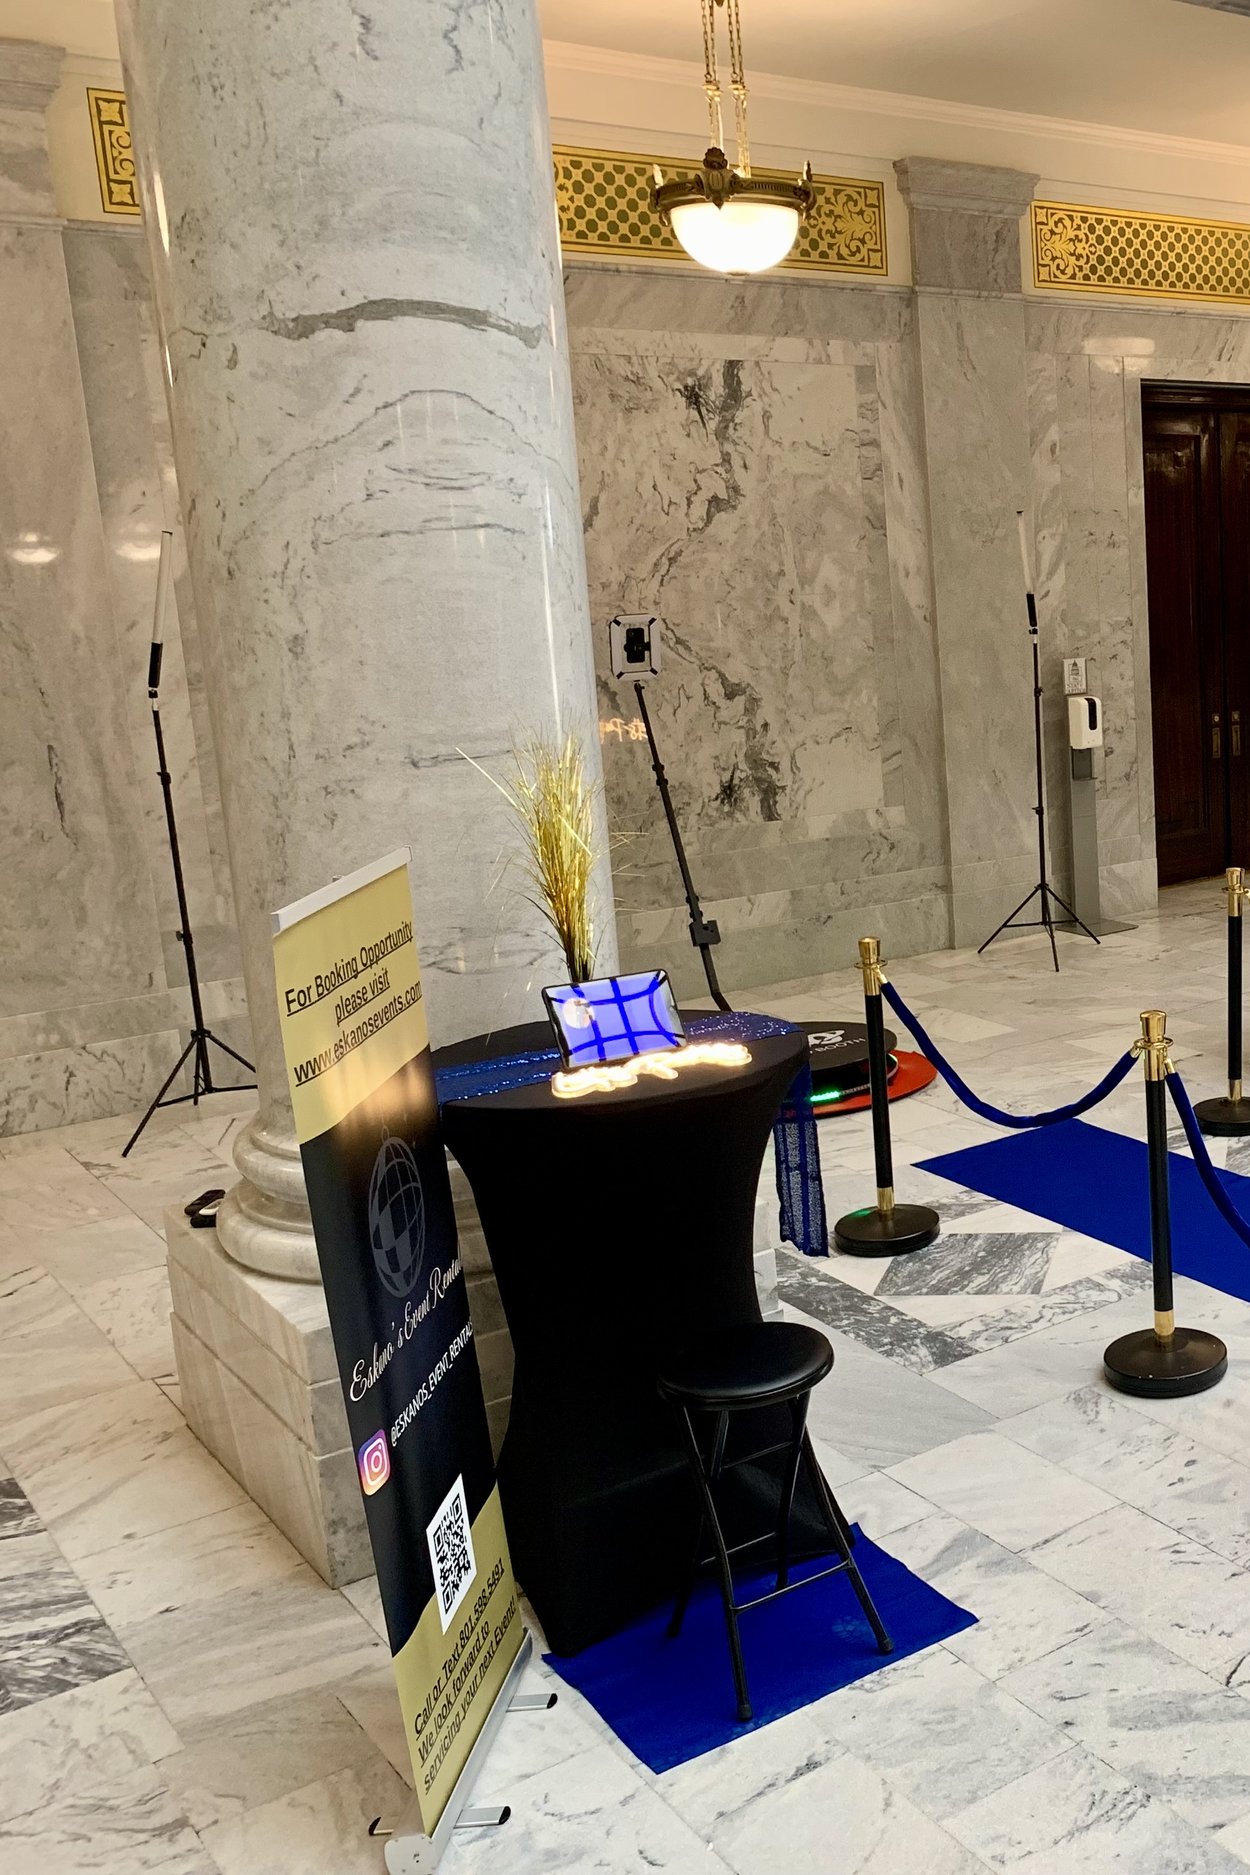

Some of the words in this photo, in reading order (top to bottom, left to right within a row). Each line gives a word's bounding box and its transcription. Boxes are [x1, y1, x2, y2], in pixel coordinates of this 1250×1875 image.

[285, 984, 312, 1015] For
[315, 956, 358, 998] Booking
[360, 920, 413, 968] Opportunity
[334, 988, 368, 1026] please
[369, 967, 391, 995] visit
[293, 980, 422, 1085] www.eskanosevents.com
[405, 1291, 430, 1340] Event
[430, 1245, 463, 1309] Rental
[415, 1692, 434, 1735] Call
[433, 1676, 441, 1701] or
[442, 1643, 460, 1680] Text
[418, 1731, 434, 1762] We
[434, 1692, 454, 1735] look
[452, 1631, 481, 1698] forward
[481, 1620, 490, 1641] to
[424, 1710, 461, 1792] servicing
[460, 1673, 478, 1719] your
[478, 1640, 496, 1680] next
[494, 1594, 517, 1646] Event!
